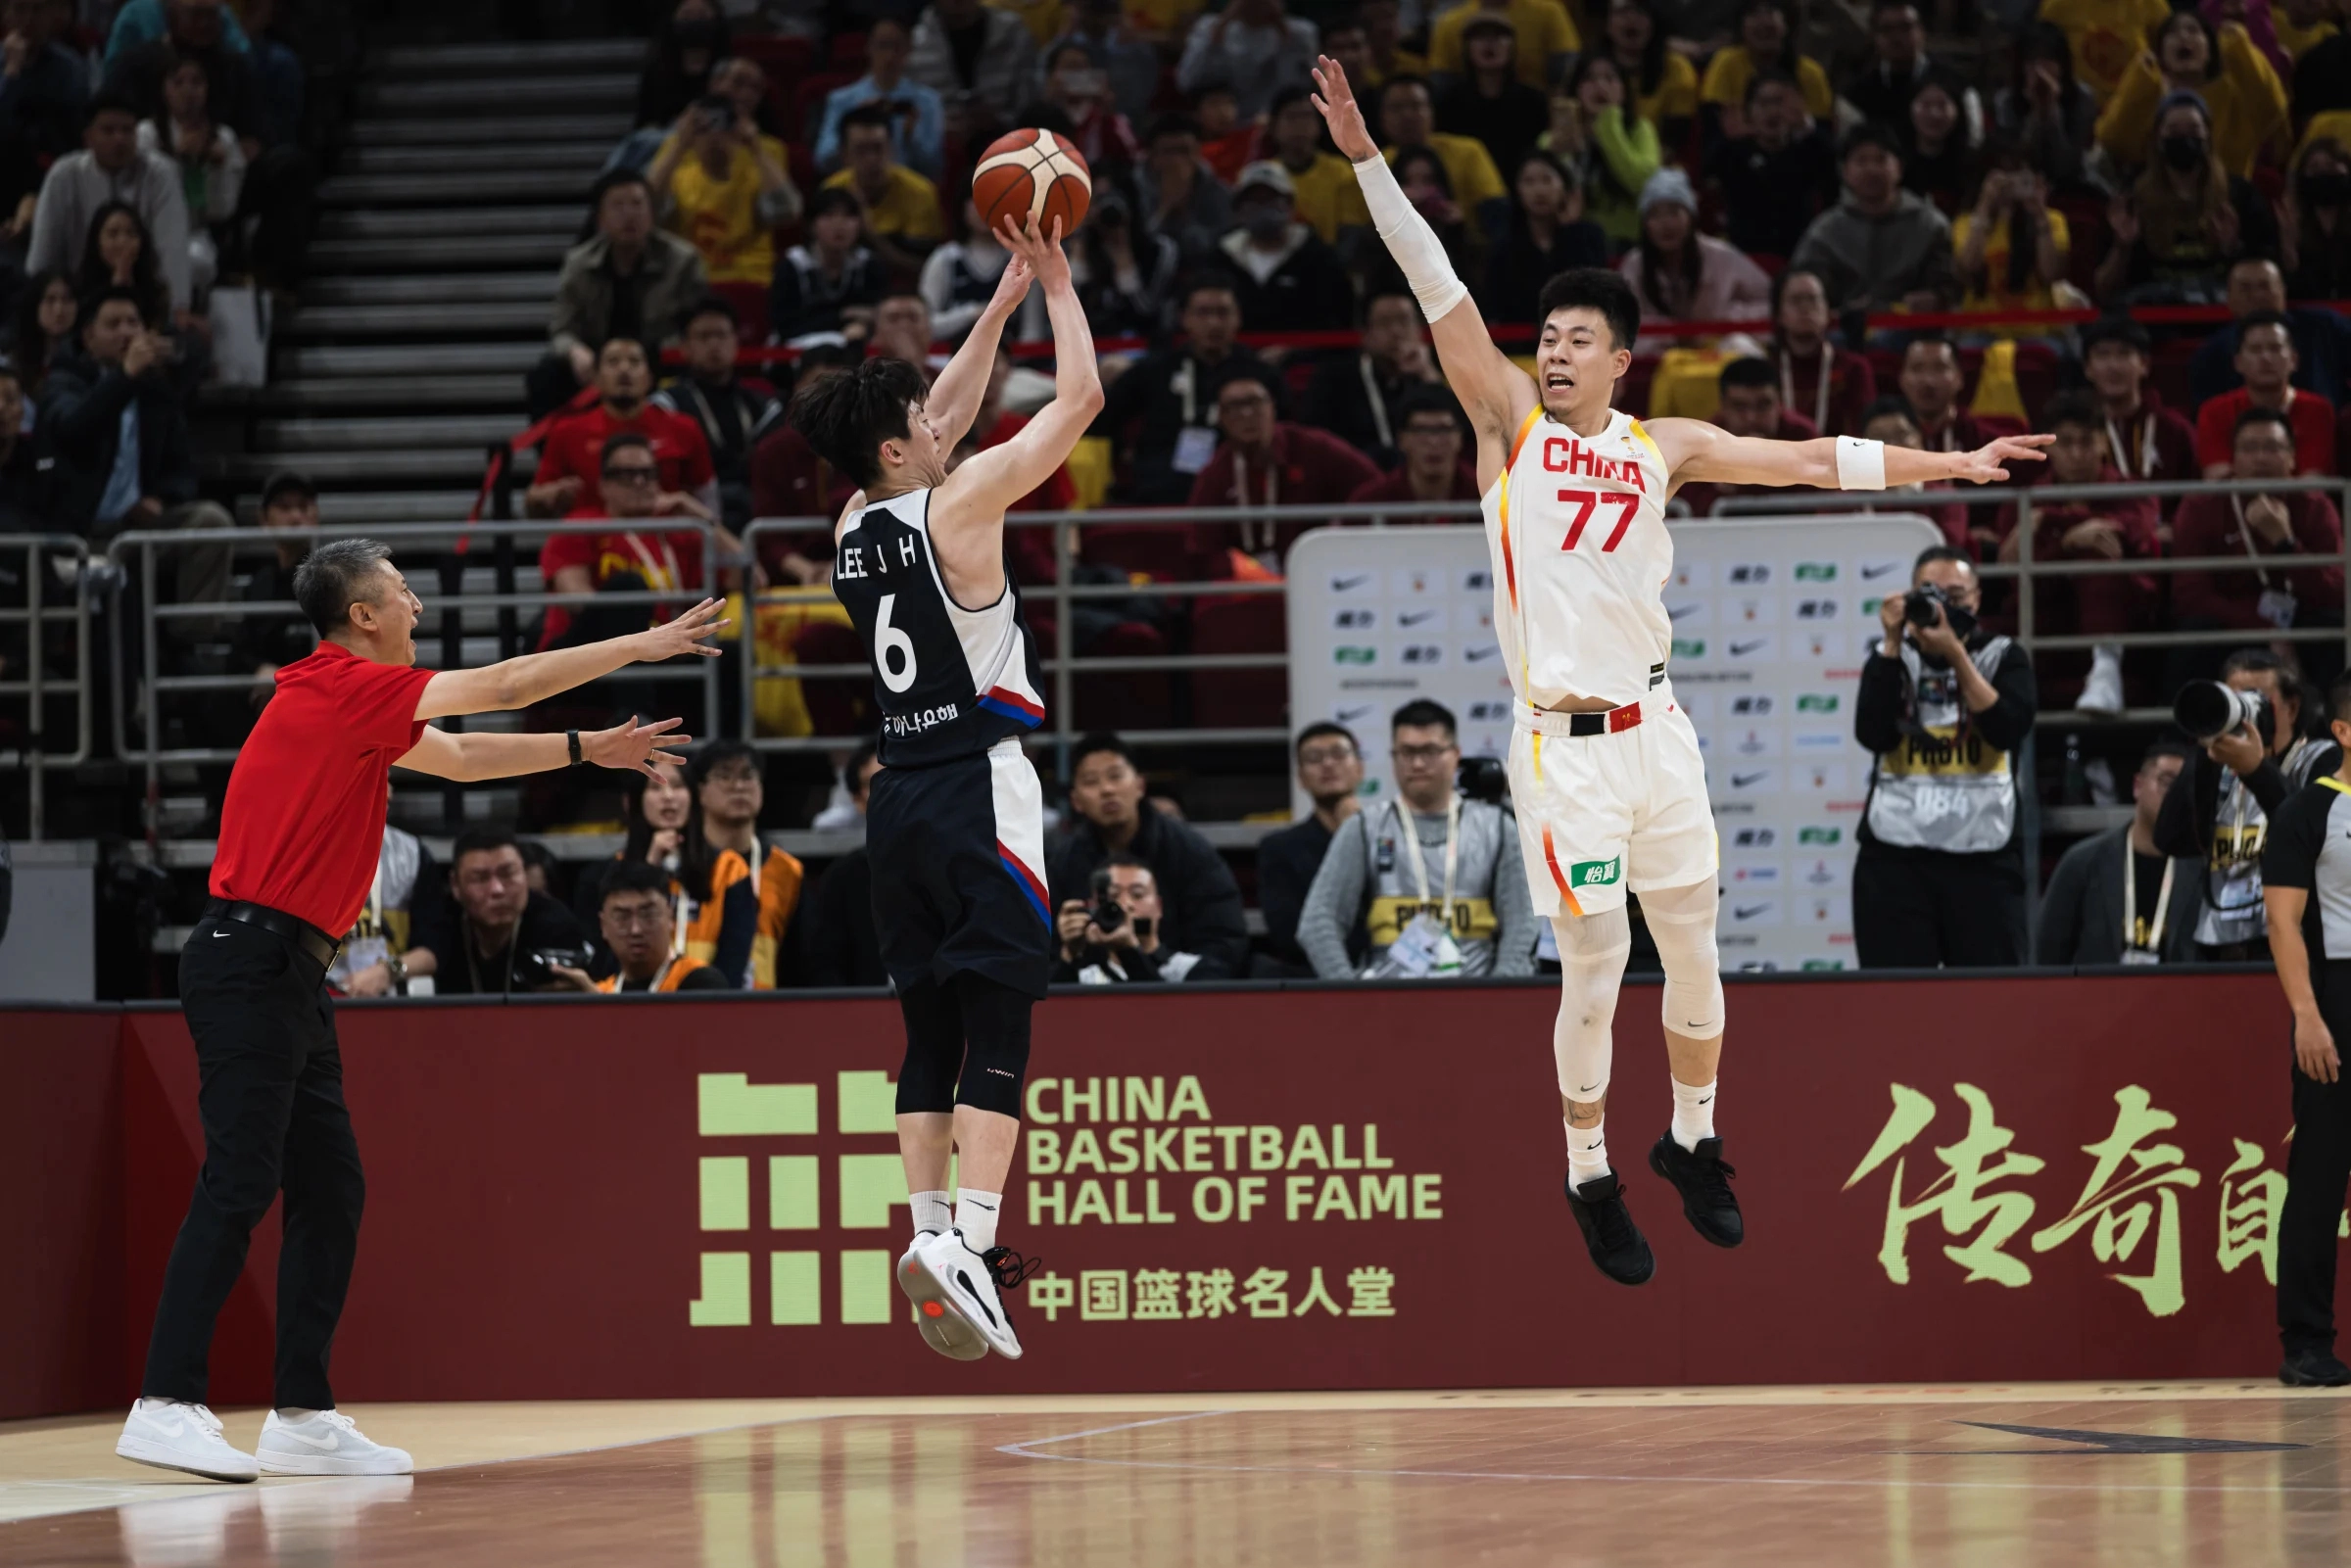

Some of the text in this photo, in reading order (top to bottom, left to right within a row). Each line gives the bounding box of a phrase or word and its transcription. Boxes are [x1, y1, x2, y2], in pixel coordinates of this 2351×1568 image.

[1543, 437, 1646, 495] CHINA
[1558, 490, 1640, 552] 77
[837, 533, 916, 580] LEE J H
[874, 593, 917, 693] 6
[1027, 1075, 1211, 1124] CHINA
[1028, 1123, 1394, 1174] BASKETBALL
[1029, 1173, 1443, 1225] HALL OF FAME
[1842, 1082, 2351, 1317] 传奇自
[1029, 1266, 1396, 1322] 中国篮球名人堂
